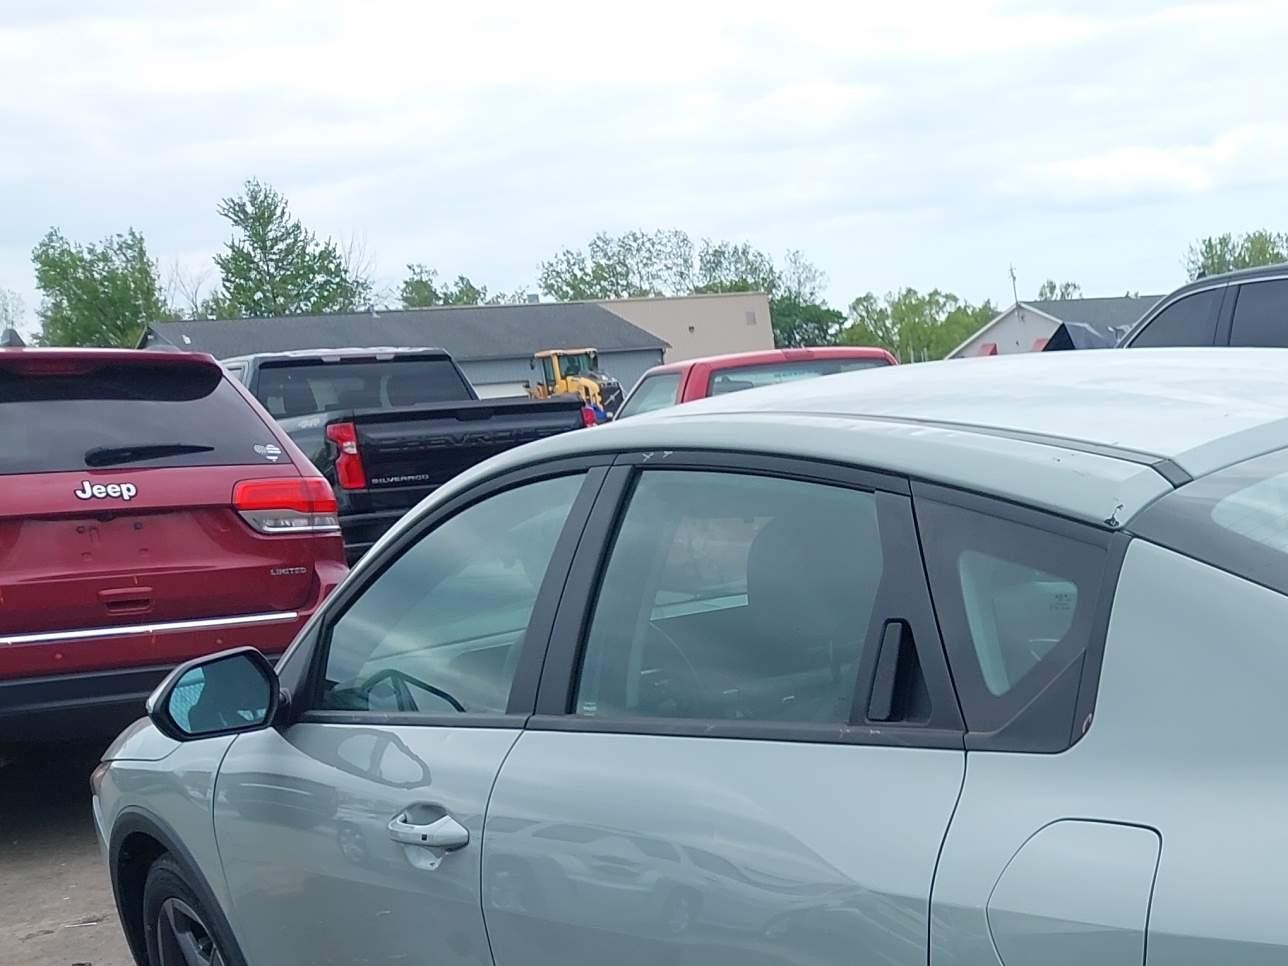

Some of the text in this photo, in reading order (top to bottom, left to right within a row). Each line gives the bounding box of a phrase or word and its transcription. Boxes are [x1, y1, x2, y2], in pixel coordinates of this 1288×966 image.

[371, 474, 430, 484] SILVERADO
[75, 480, 137, 500] Jeep
[270, 567, 306, 576] LIMITED
